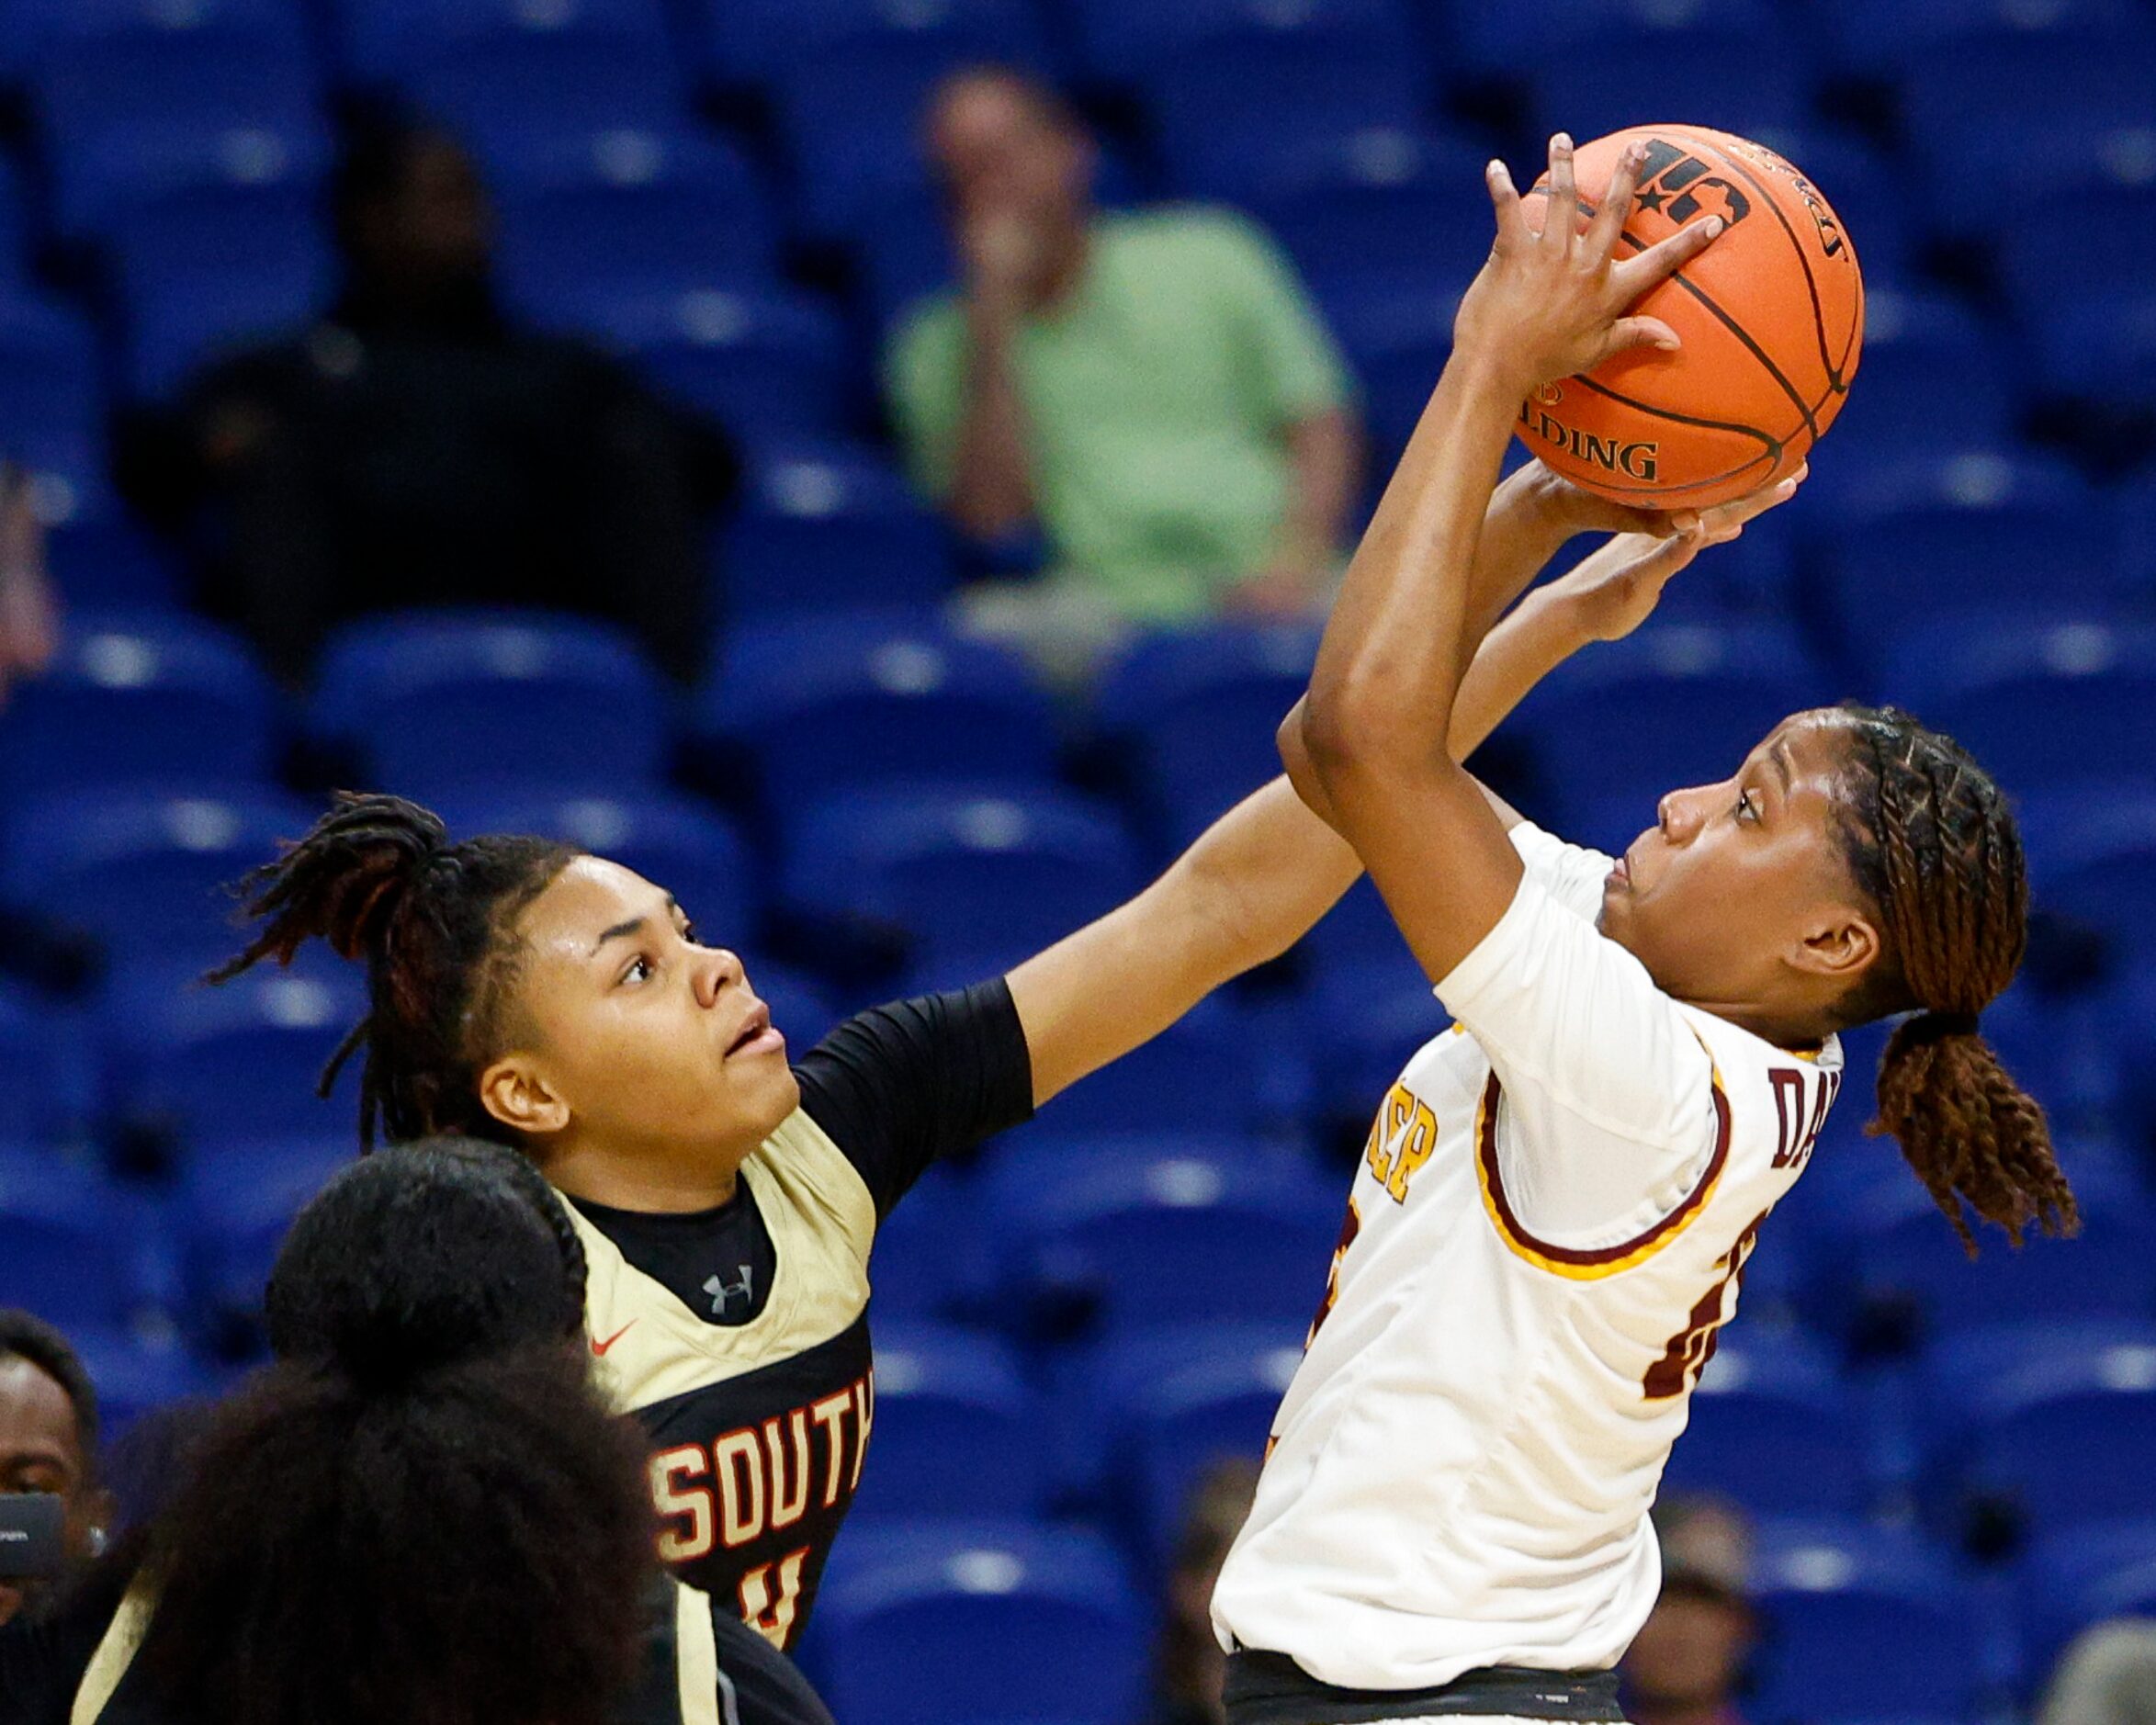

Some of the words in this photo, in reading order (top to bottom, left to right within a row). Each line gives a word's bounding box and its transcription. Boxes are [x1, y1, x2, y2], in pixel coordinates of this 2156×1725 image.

[1518, 398, 1659, 484] LDING
[1367, 1078, 1439, 1207] ER
[648, 1369, 875, 1563] SOUTH
